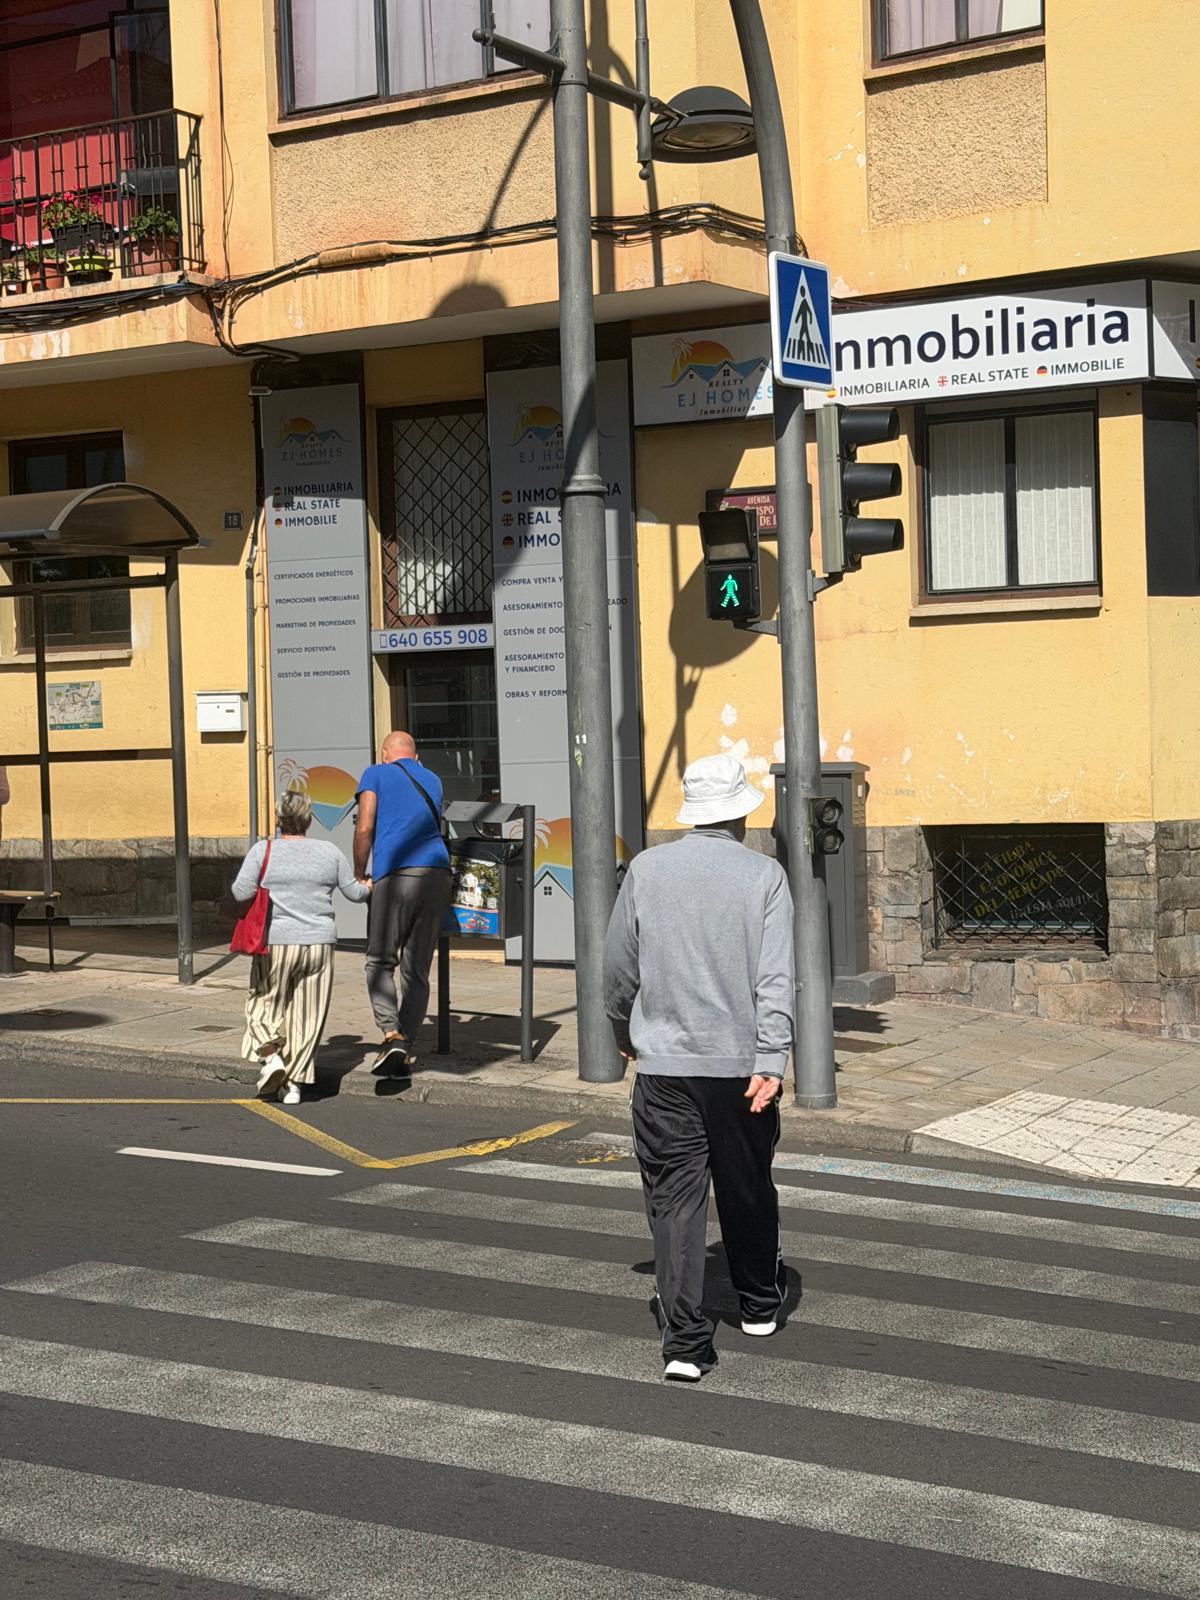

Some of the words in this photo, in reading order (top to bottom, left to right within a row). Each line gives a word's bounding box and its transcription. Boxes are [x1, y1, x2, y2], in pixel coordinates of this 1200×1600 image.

[834, 298, 1130, 372] nmobiliaria
[1051, 358, 1125, 376] IMMOBILIE
[951, 371, 985, 386] REAL
[988, 367, 1029, 383] STATE
[839, 377, 930, 398] INMOBILIARIA
[678, 394, 696, 408] EJ
[706, 387, 773, 405] HOMES
[300, 447, 343, 460] HOMES
[519, 450, 535, 463] EJ
[284, 481, 354, 496] INMOBILIARIA
[284, 500, 307, 512] REAL
[311, 499, 341, 510] STATE
[747, 495, 770, 505] AVENIDA
[227, 515, 238, 526] 18
[284, 514, 338, 527] IMMOBILIE
[518, 511, 551, 526] REAL
[274, 571, 314, 580] CERTIFICADOS
[502, 578, 531, 586] COMPRA
[275, 596, 316, 605] PROMOCIONES
[318, 594, 360, 602] INMOBILIARIAS
[502, 601, 563, 611] ASESORAMIENTO
[276, 621, 308, 629] MARKETING
[318, 619, 357, 627] PROPIEDADES
[503, 626, 534, 636] GESTIÓN
[537, 627, 546, 635] DE
[388, 632, 417, 648] 640
[423, 630, 452, 646] 655
[458, 628, 488, 645] 908
[304, 645, 336, 653] POSTVENTA
[504, 652, 564, 661] ASESORAMIENTO
[277, 670, 302, 679] GESTIÓN
[312, 669, 351, 677] PROPIEDADES
[512, 665, 555, 673] FINANCIERO
[505, 690, 529, 698] OBRAS
[539, 689, 567, 697] REFORM
